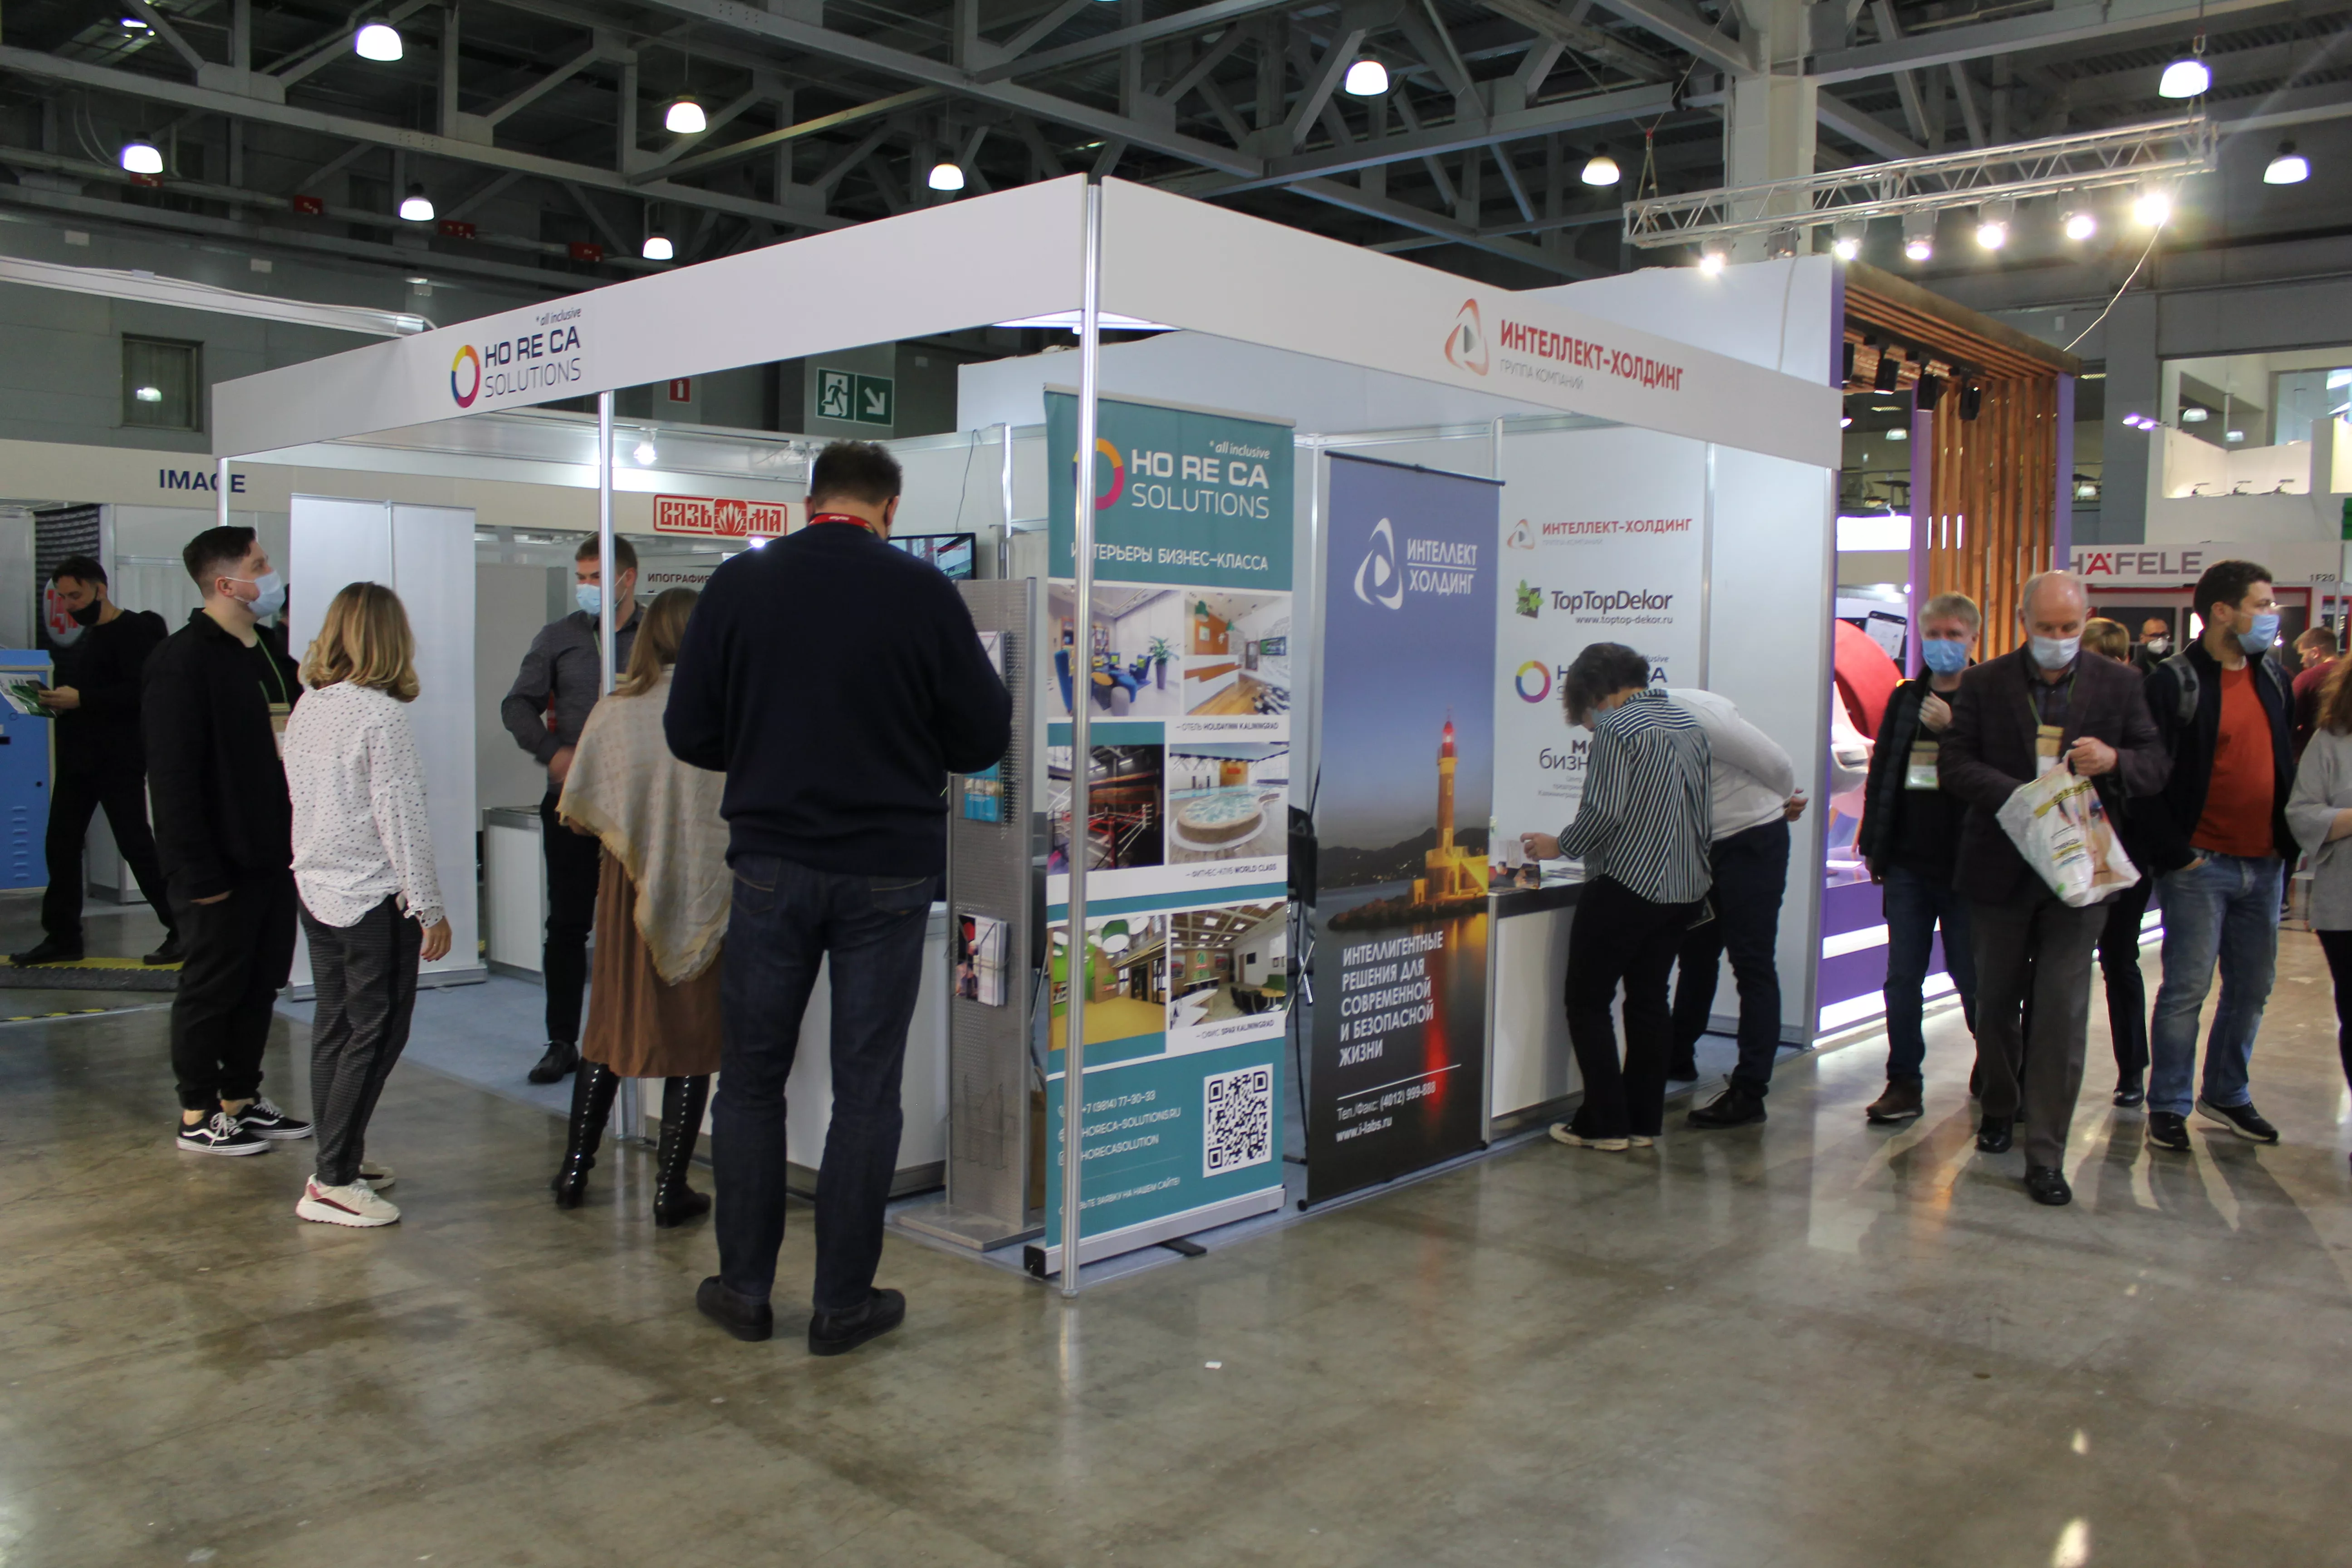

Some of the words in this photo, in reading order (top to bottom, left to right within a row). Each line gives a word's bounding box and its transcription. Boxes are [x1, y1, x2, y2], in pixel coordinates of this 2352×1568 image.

[550, 307, 582, 324] inclusive
[485, 341, 511, 368] HO
[517, 333, 544, 362] RE
[549, 326, 581, 354] CA
[1500, 319, 1684, 392] ИНТЕЛЛЕКТ-ХОЛДИНГ
[485, 357, 582, 398] SOLUTIONS
[1229, 444, 1270, 460] inclusive
[1131, 449, 1174, 478] HO
[1181, 456, 1220, 484] RE
[1228, 461, 1269, 490] CA
[1131, 482, 1270, 519] SOLUTIONS
[1542, 519, 1693, 535] ИНТЕЛЛЕКТ-ХОЛДИНГ
[1071, 542, 1152, 563] ИТЕРЬЕРЫ
[1158, 548, 1269, 572] БИЗНЕС-КЛАССА
[1407, 539, 1478, 566] ИНТЕЛЛЕКТ
[1409, 569, 1475, 596] ХОЛДИНГ
[1551, 589, 1674, 615] TopTopDekor
[1575, 615, 1673, 626] www.toptop-dekor.ru
[1343, 931, 1444, 967] ИНТЕЛЛИГЕНТНЫЕ
[1342, 963, 1397, 992] РЕШЕНИЯ
[1400, 957, 1426, 983] ДЛЯ
[1341, 975, 1432, 1017] СОВРЕМЕННОЙ
[1340, 1023, 1350, 1043] И
[1353, 999, 1434, 1040] БЕЗОПАСНОЙ
[1338, 1039, 1383, 1068] ЖИЗНИ
